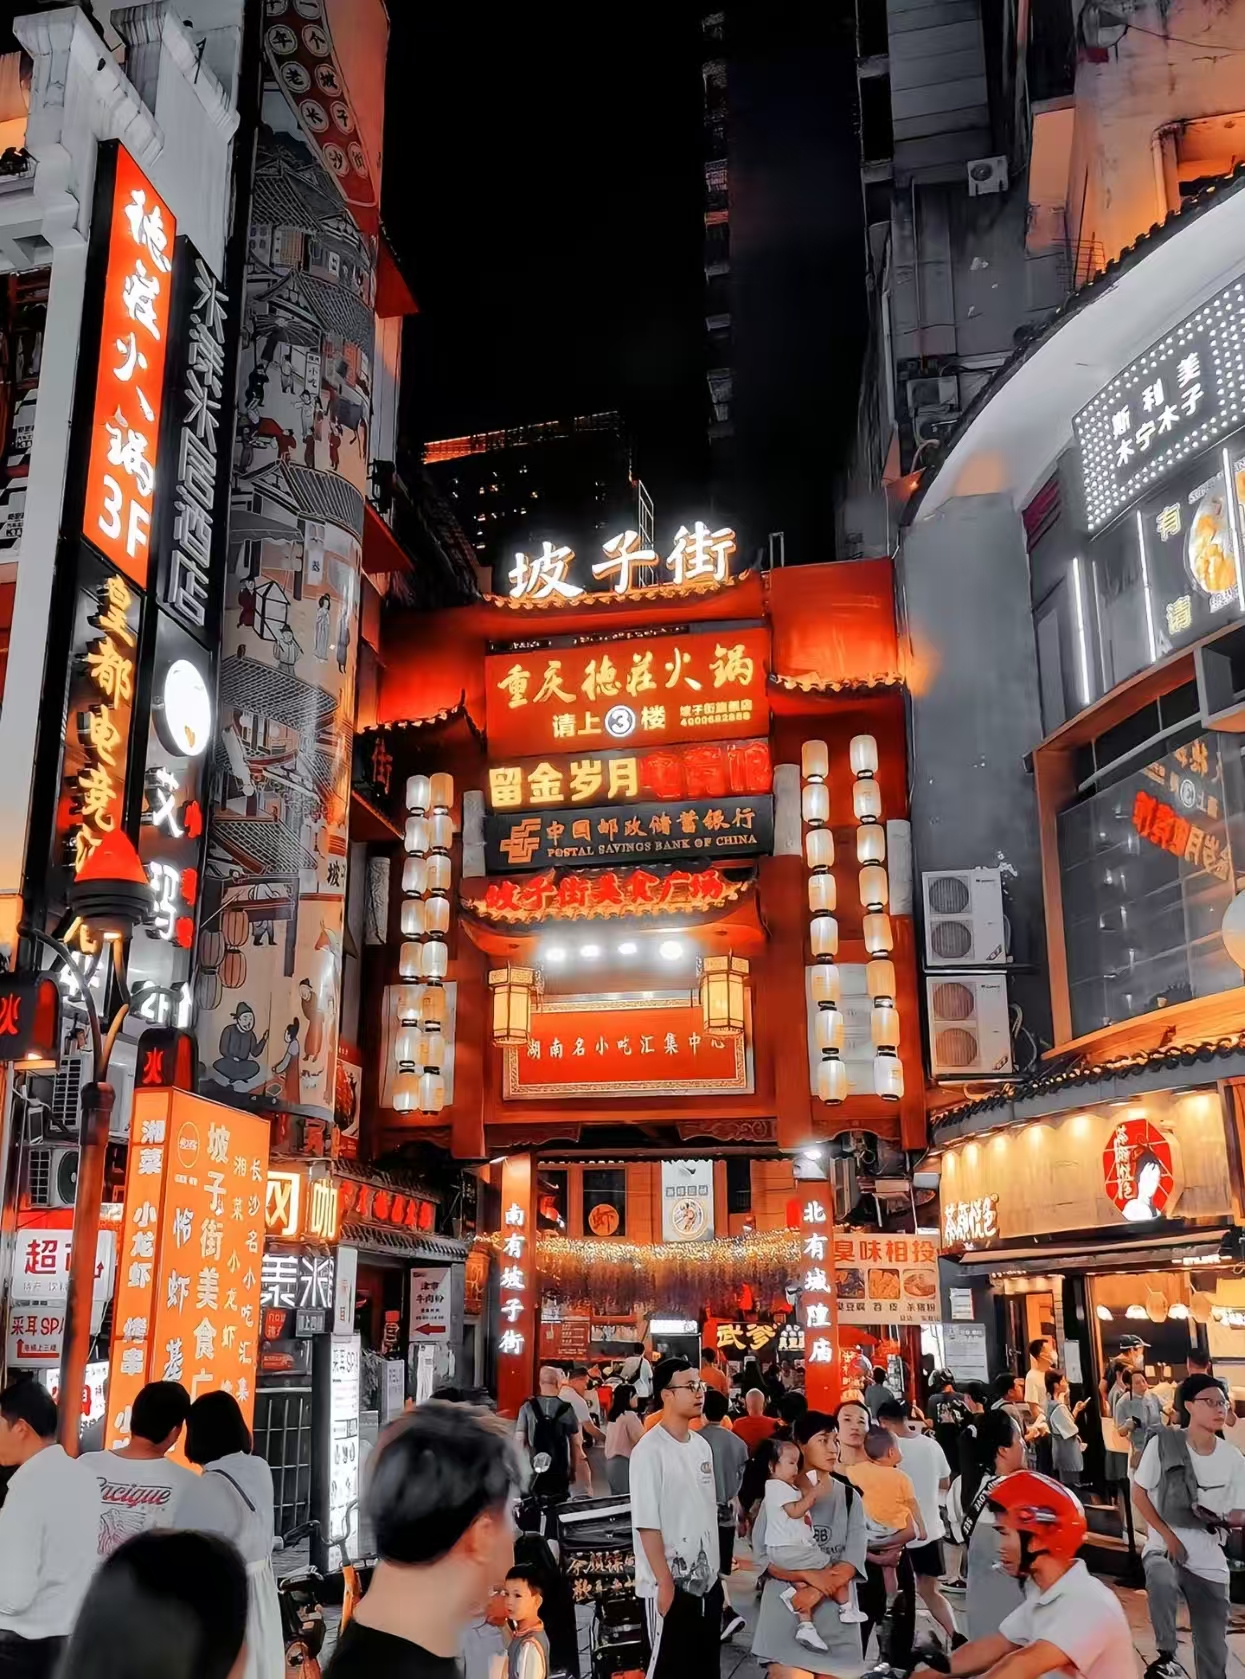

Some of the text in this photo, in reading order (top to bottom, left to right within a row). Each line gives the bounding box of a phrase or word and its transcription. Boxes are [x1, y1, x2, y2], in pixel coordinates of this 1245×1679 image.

[105, 189, 172, 497] 德庄火锅
[98, 474, 150, 557] 3F
[508, 521, 737, 599] 坡子街
[497, 643, 754, 709] 重庆德庄火锅
[489, 757, 639, 808] 留金岁月
[546, 807, 757, 847] 中国邮政储蓄银行
[547, 834, 758, 858] POSTAL SAVINGS BANK OF CHINA
[526, 1032, 727, 1061] 湖南名小吃汇集中心
[128, 1201, 158, 1289] 小龙虾
[498, 1202, 526, 1355] 南有坡子街
[803, 1200, 832, 1363] 北有城隍庙
[834, 1240, 936, 1263] 臭味相投
[221, 1249, 241, 1350] 小龙虾
